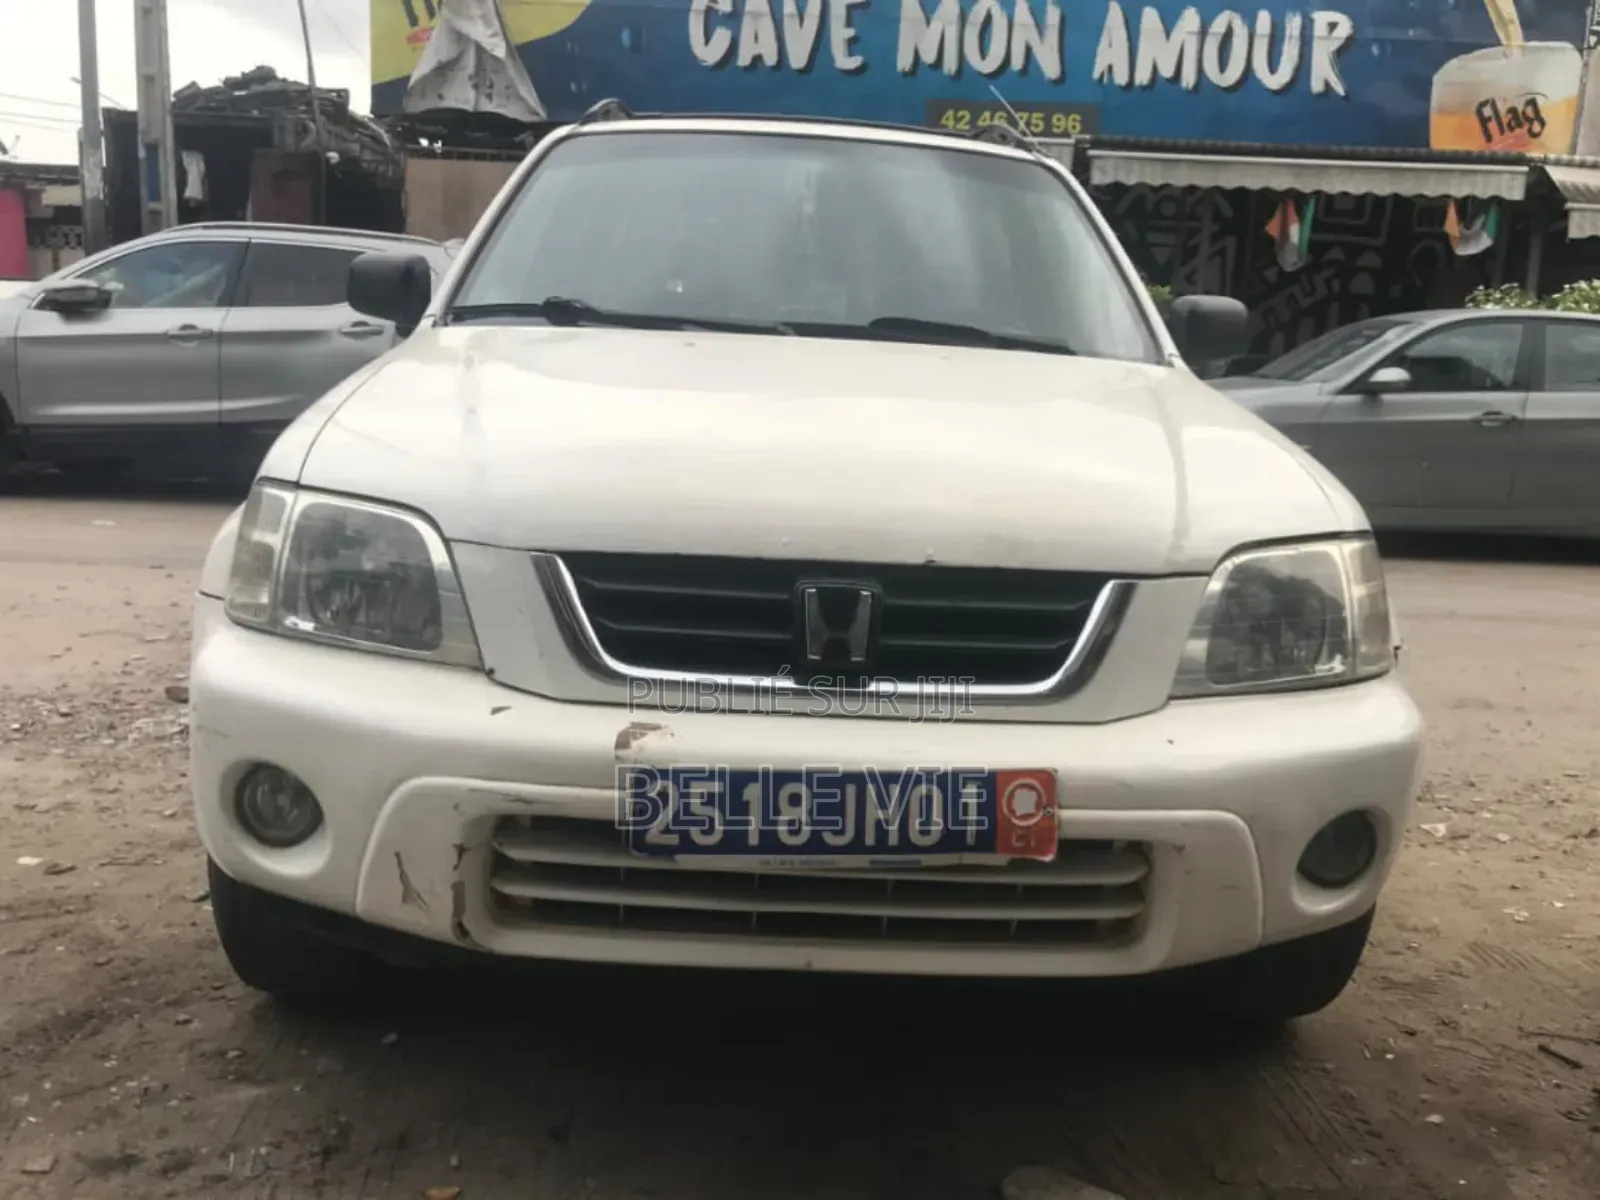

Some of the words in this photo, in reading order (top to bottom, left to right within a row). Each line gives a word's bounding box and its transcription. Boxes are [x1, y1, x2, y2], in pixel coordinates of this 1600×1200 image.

[688, 0, 866, 71] CAVE
[896, 0, 1063, 82] MON
[1093, 4, 1354, 97] AMOUR
[940, 109, 971, 131] 42
[1015, 112, 1046, 133] 75
[1051, 113, 1082, 134] 96
[1475, 96, 1547, 143] Flag
